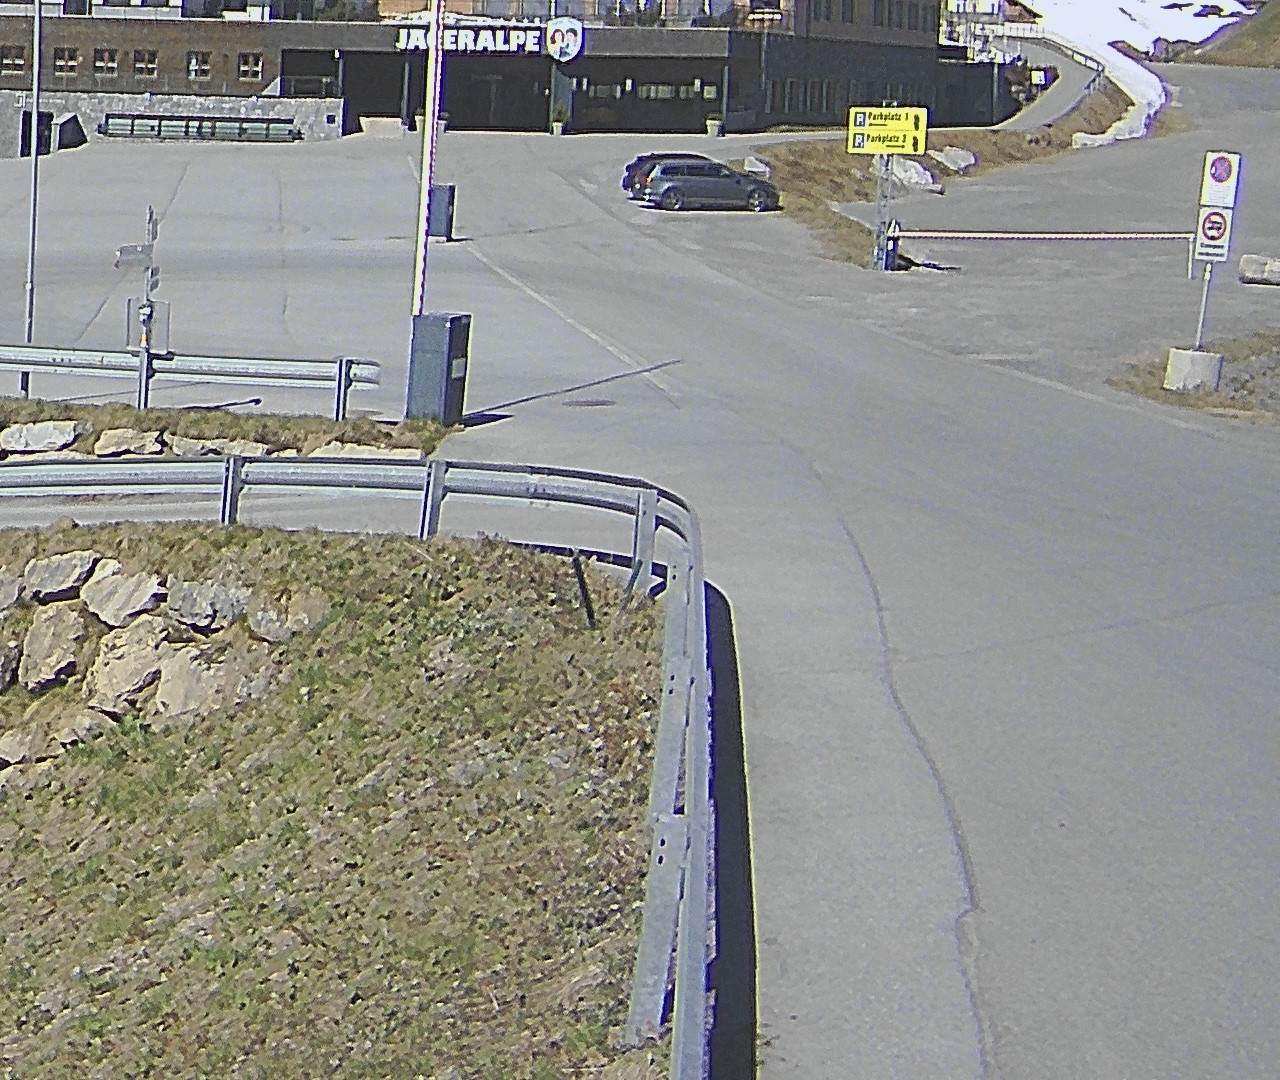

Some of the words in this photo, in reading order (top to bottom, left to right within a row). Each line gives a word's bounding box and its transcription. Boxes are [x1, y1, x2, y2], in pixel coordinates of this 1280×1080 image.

[395, 28, 541, 52] JÄERALPE
[868, 112, 901, 122] Parkplatz
[866, 133, 899, 144] Parkplatz
